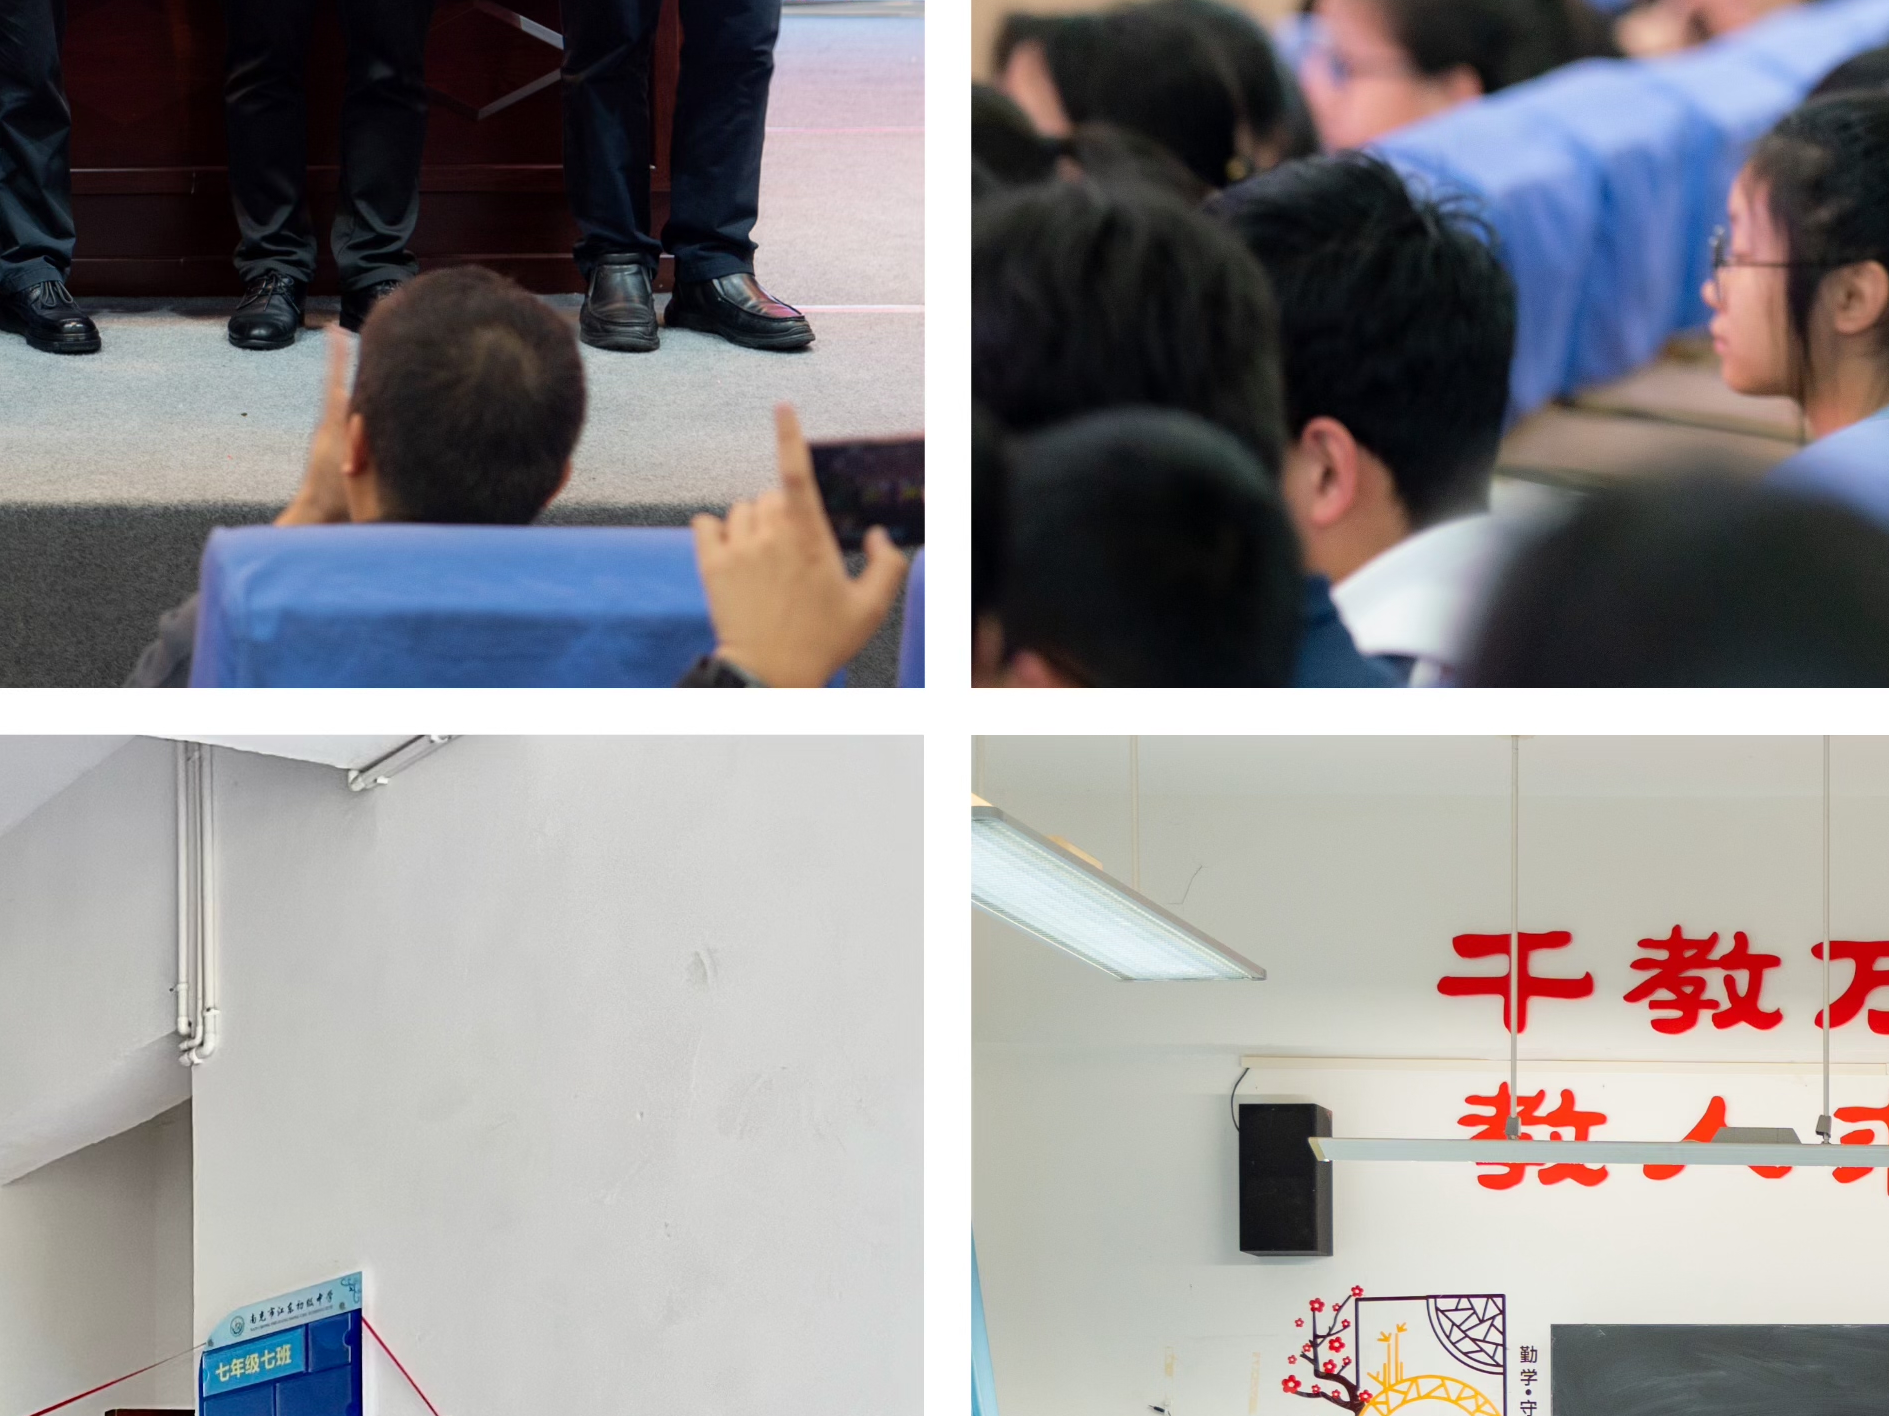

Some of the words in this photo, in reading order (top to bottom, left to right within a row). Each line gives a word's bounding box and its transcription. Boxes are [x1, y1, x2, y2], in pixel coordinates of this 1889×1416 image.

[216, 1344, 292, 1382] 七年级七班
